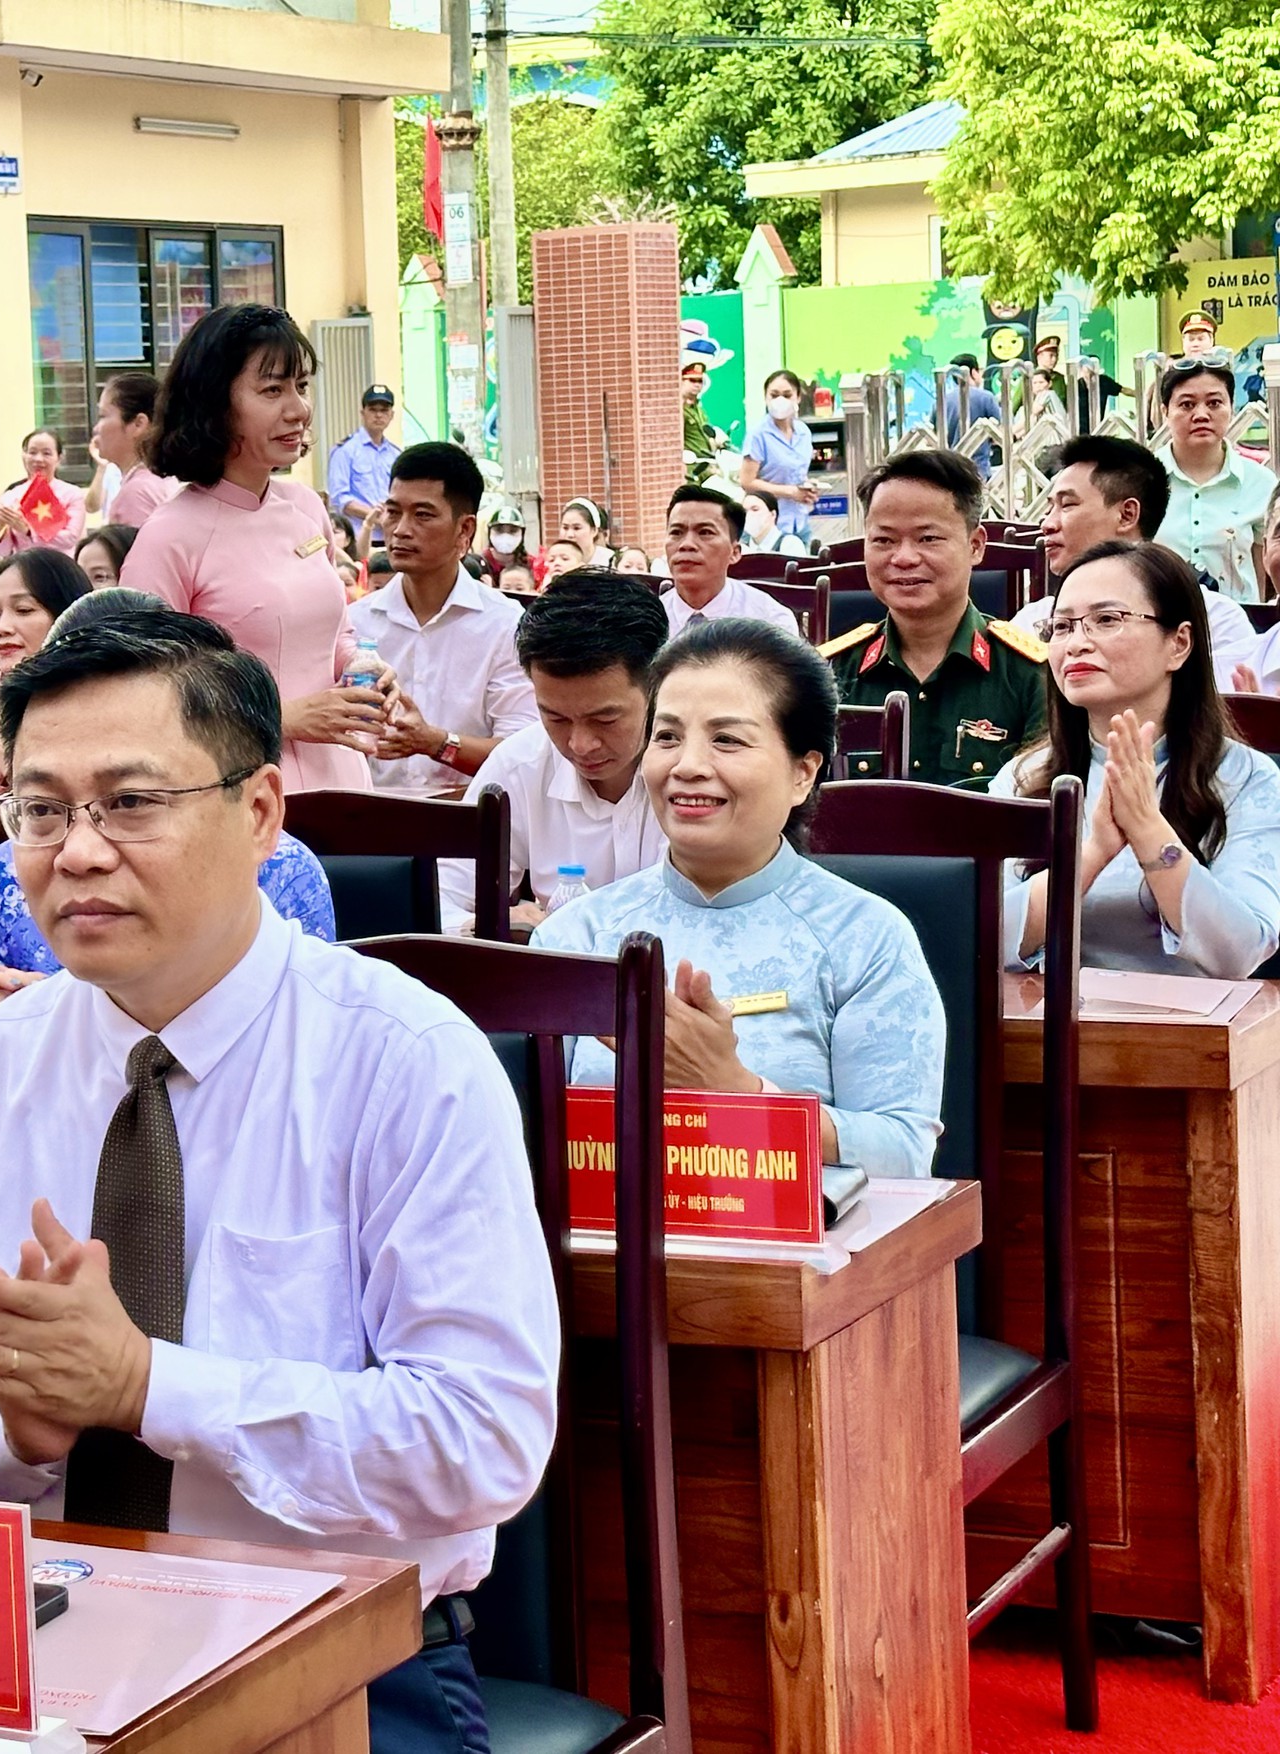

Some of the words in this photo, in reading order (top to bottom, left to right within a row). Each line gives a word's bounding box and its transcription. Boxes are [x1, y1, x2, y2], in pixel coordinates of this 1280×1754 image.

[1208, 271, 1237, 288] ĐẢM
[1242, 269, 1270, 286] BẢO
[1228, 292, 1243, 308] LÀ
[663, 1113, 681, 1127] NG
[685, 1112, 707, 1129] CHÍ
[667, 1144, 749, 1179] PHƯƠNG
[754, 1149, 798, 1181] ANH
